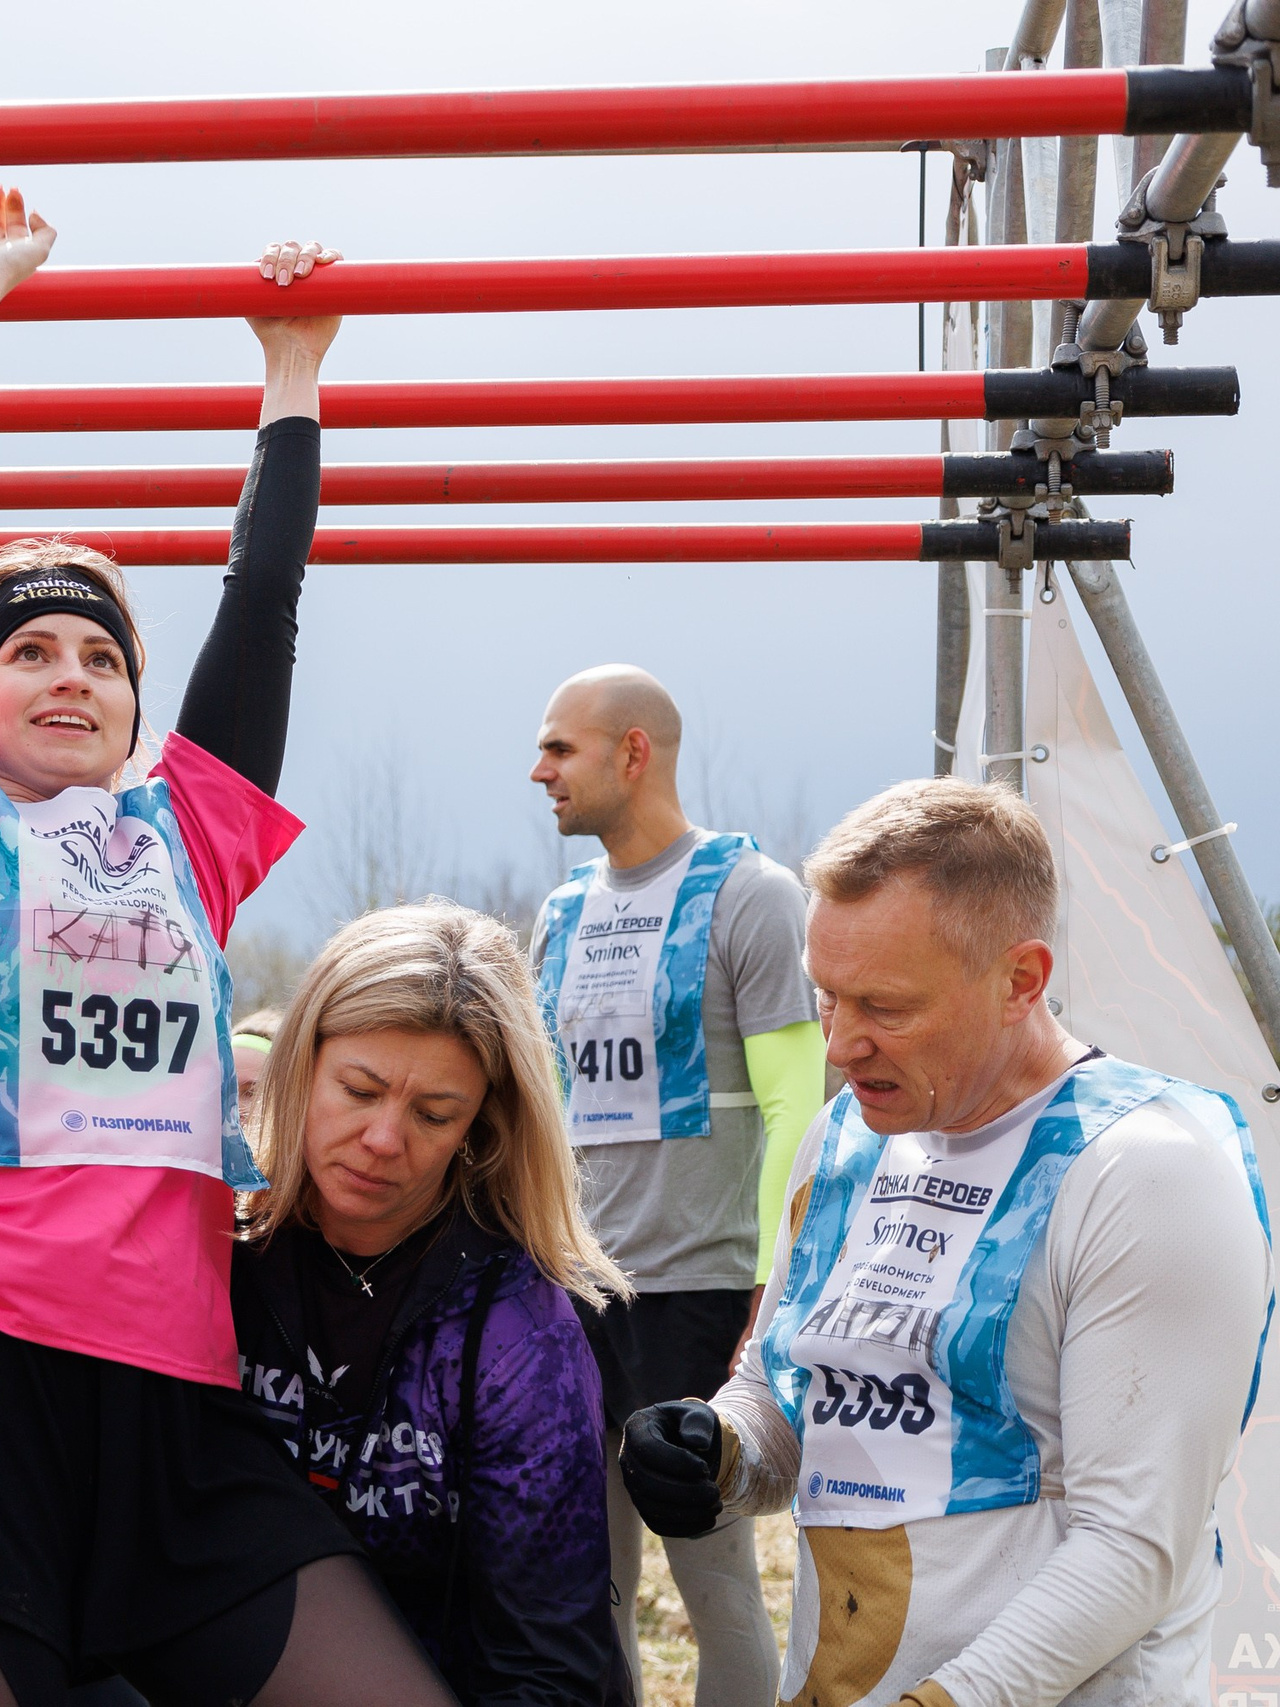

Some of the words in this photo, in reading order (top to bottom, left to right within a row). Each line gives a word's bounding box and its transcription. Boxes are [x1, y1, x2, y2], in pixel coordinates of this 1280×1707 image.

[13, 577, 92, 595] Sminex
[28, 587, 85, 599] team
[580, 921, 613, 936] ГОНКА
[615, 916, 663, 930] ГЕРОЕВ
[47, 904, 202, 982] КАТЯ
[583, 942, 643, 964] Sminex
[41, 989, 200, 1074] 5397
[570, 1037, 644, 1082] 410
[91, 1115, 193, 1134] ГАЗПРОМБАНК
[872, 1174, 910, 1197] ГОНКА
[913, 1174, 994, 1207] ГЕРОЕВ
[866, 1215, 954, 1256] Sminex
[854, 1278, 926, 1300] DEVELOPMENT
[826, 1479, 906, 1503] ГАЗПРОМБАНК
